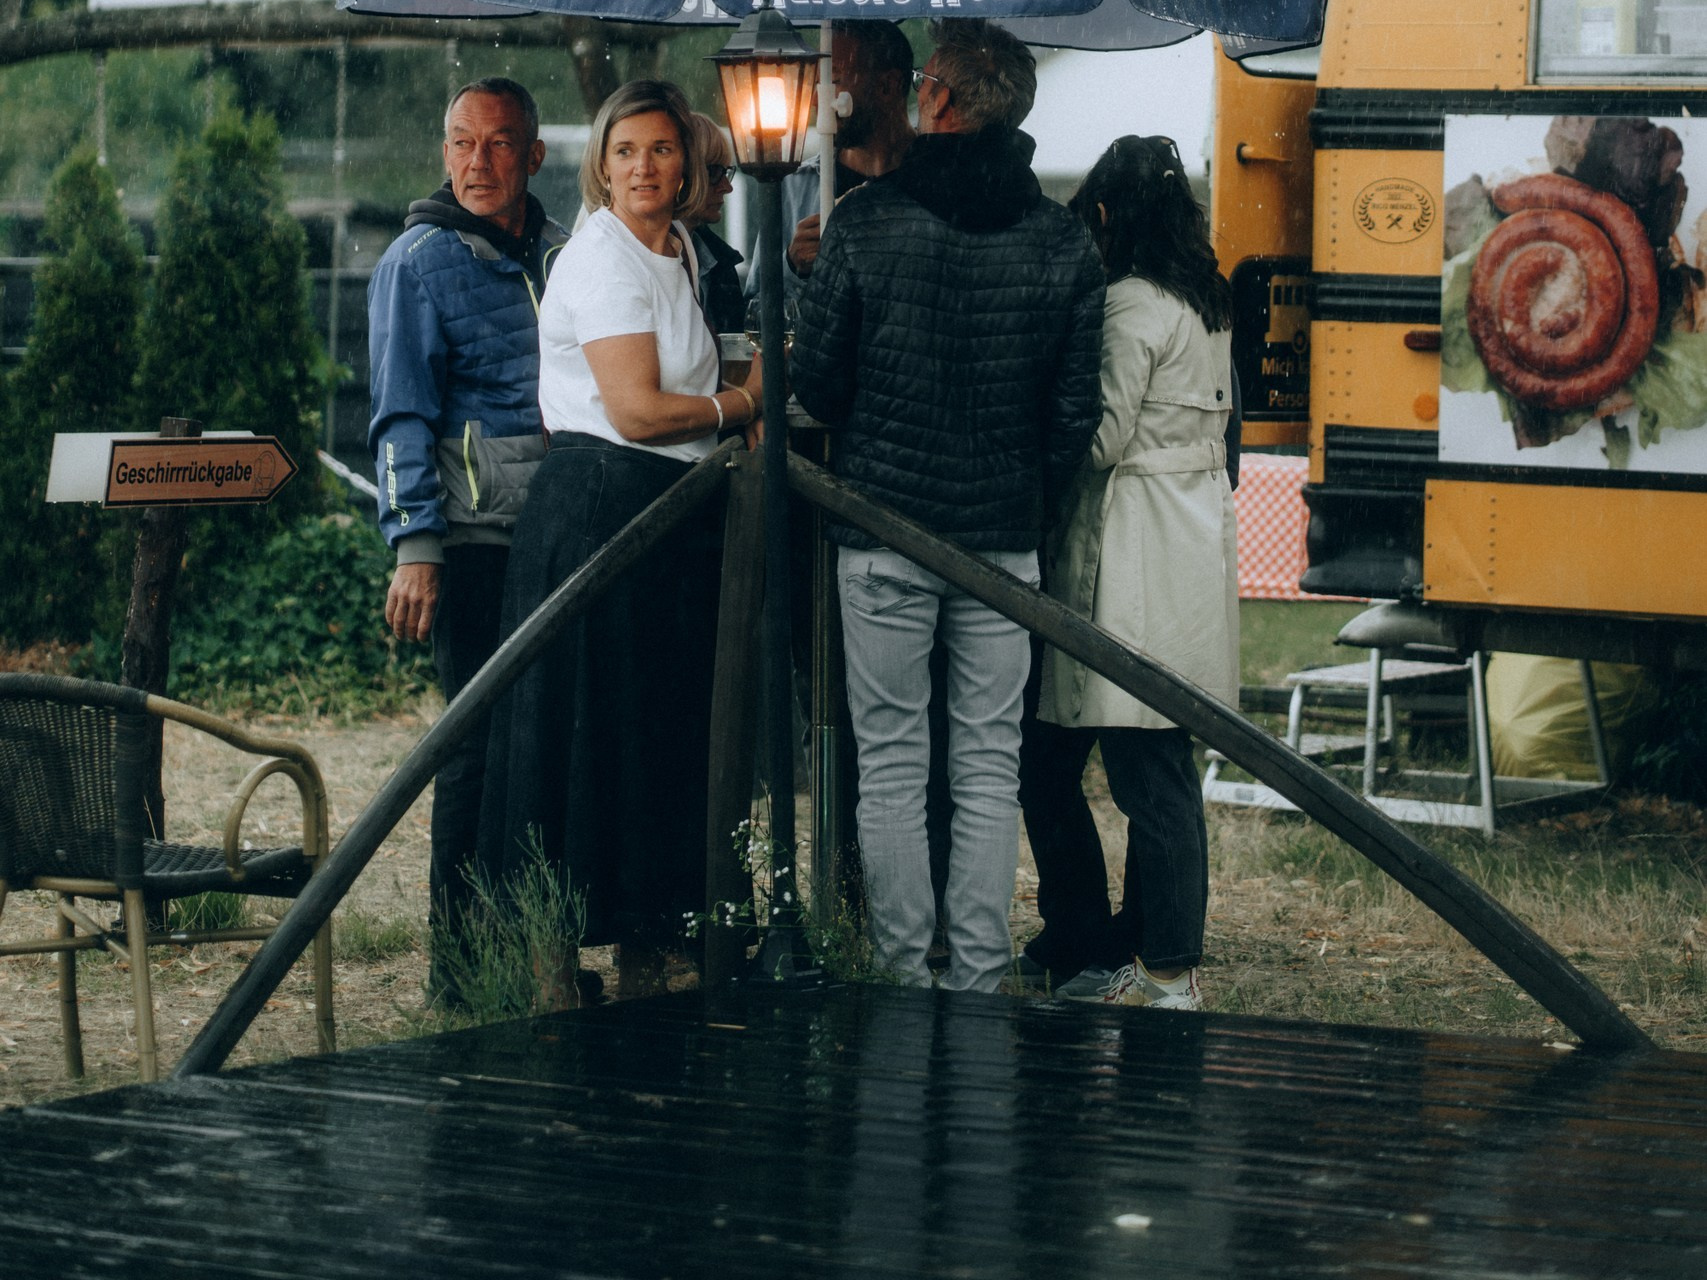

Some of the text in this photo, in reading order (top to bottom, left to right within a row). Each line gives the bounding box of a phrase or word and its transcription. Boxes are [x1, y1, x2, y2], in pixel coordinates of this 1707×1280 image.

[407, 226, 442, 254] FACTORY
[1261, 356, 1295, 376] Mich
[116, 460, 253, 487] Geschirrrückgabe
